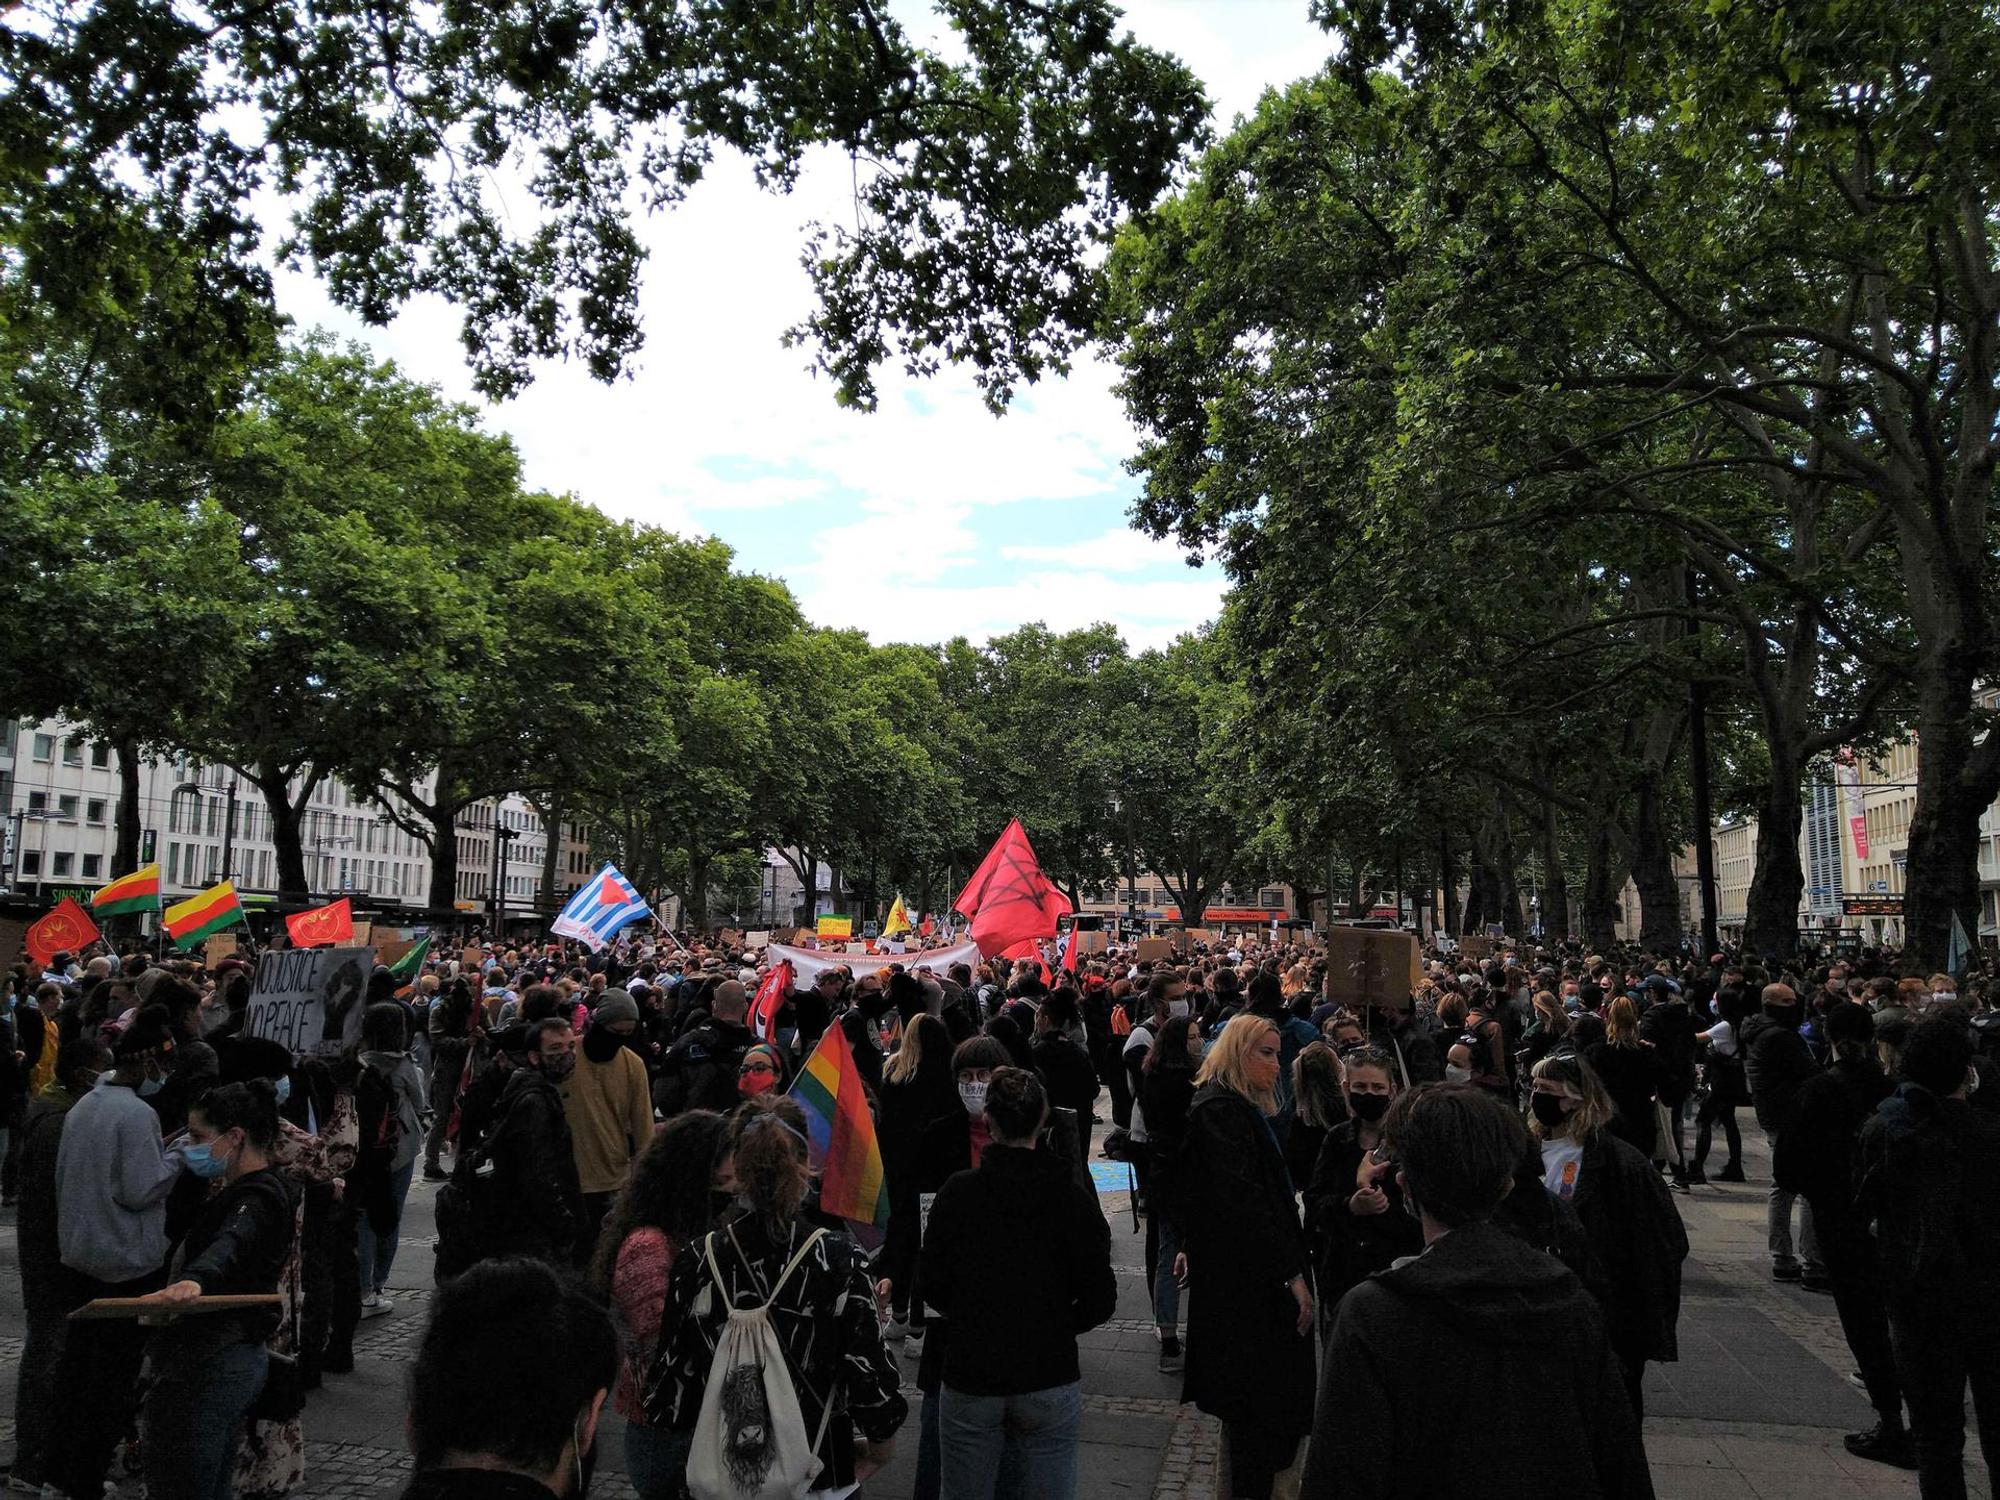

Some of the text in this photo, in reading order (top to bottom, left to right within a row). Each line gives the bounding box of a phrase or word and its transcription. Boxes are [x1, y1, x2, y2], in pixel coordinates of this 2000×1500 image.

[251, 950, 323, 994] NO JUSTICE
[243, 999, 314, 1053] NO PEACE
